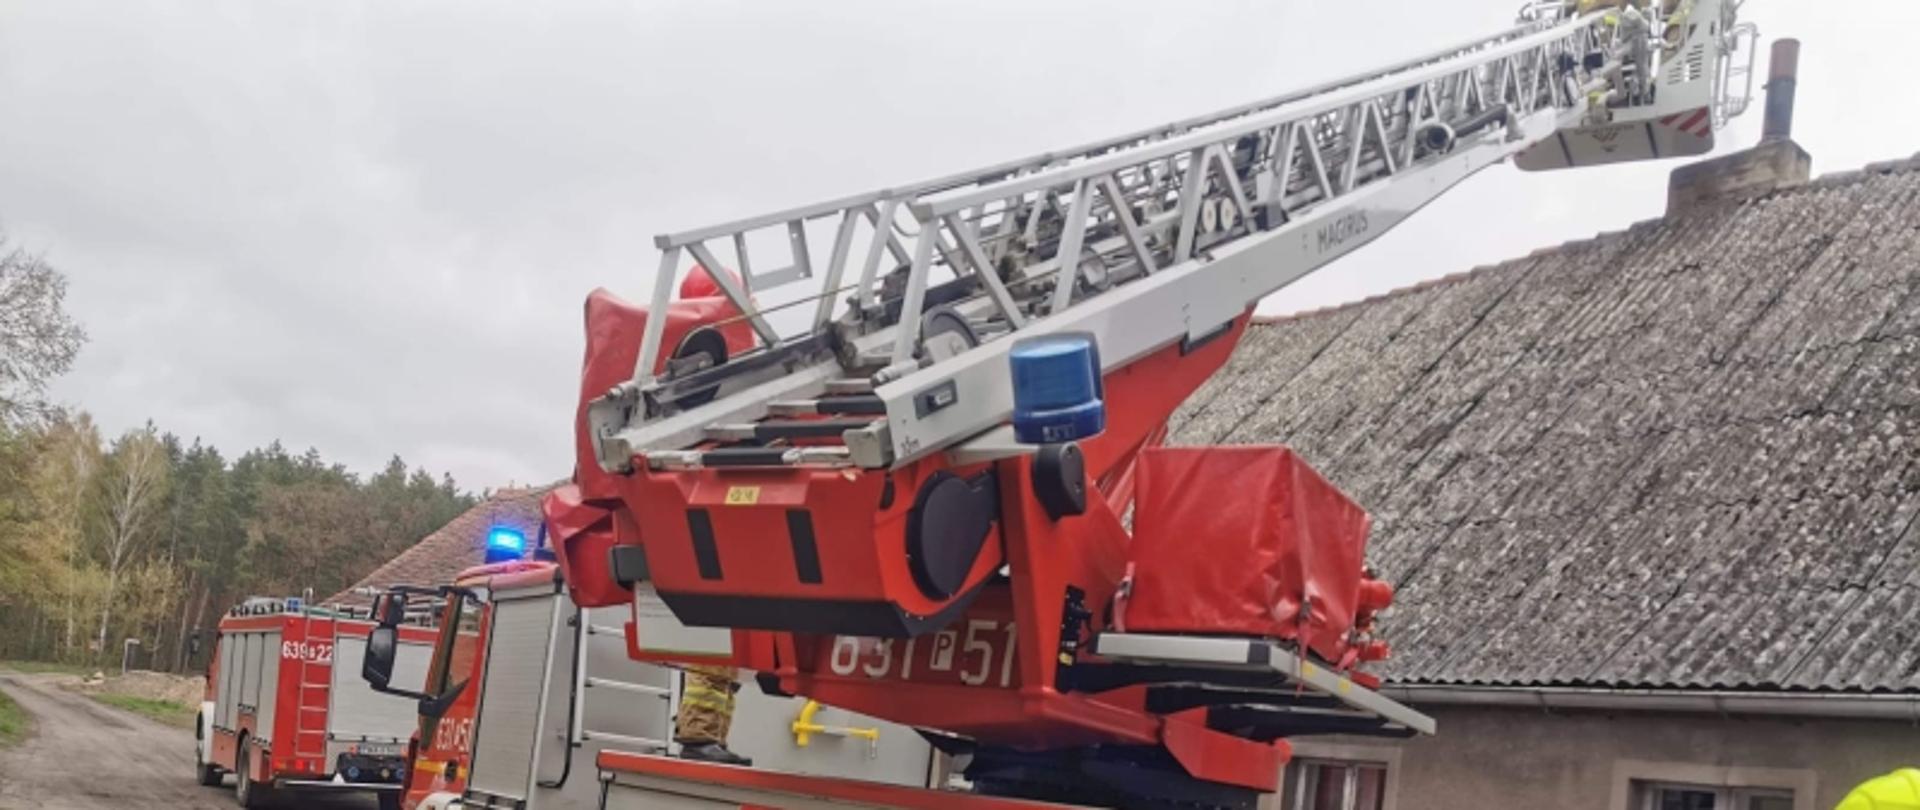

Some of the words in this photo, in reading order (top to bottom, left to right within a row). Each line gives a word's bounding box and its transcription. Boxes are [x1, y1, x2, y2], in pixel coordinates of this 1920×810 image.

[1317, 210, 1369, 254] MAGIRUS
[282, 640, 308, 659] 639
[830, 634, 915, 680] 631
[931, 631, 955, 670] P
[960, 619, 1017, 688] 51
